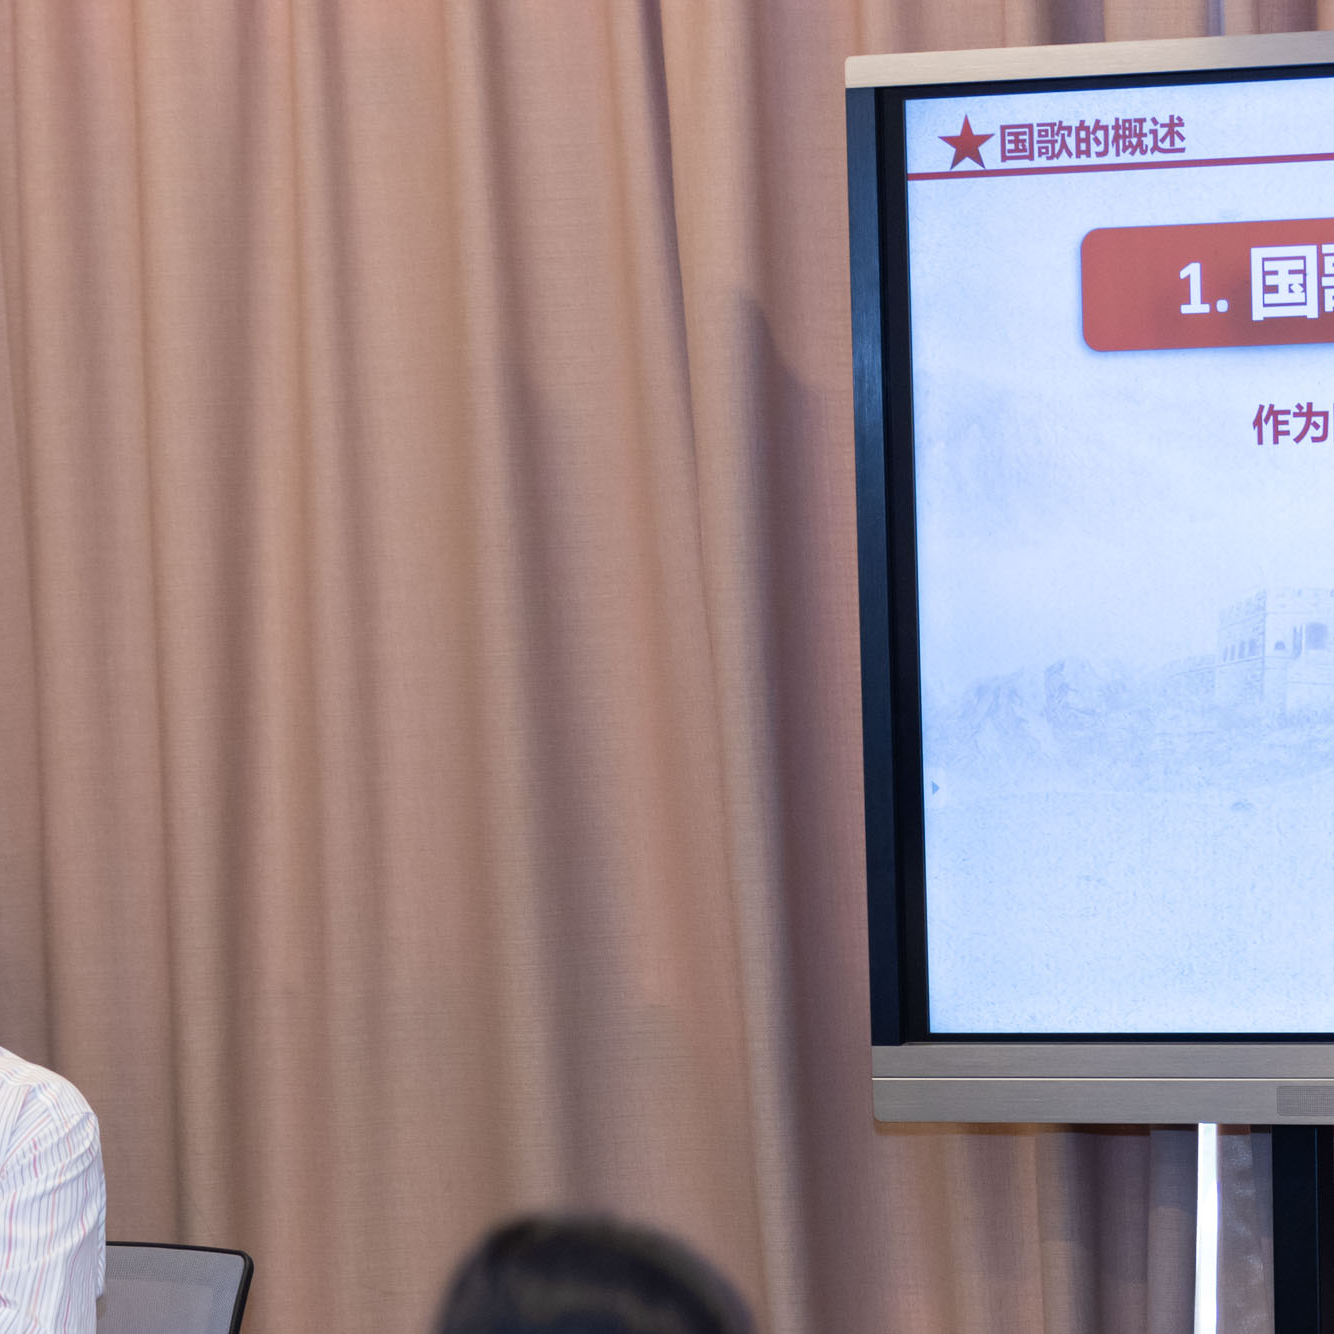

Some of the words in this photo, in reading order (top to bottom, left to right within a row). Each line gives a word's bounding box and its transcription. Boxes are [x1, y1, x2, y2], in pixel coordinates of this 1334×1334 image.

[1000, 115, 1186, 163] 国歌的概述
[1178, 261, 1230, 315] 1.
